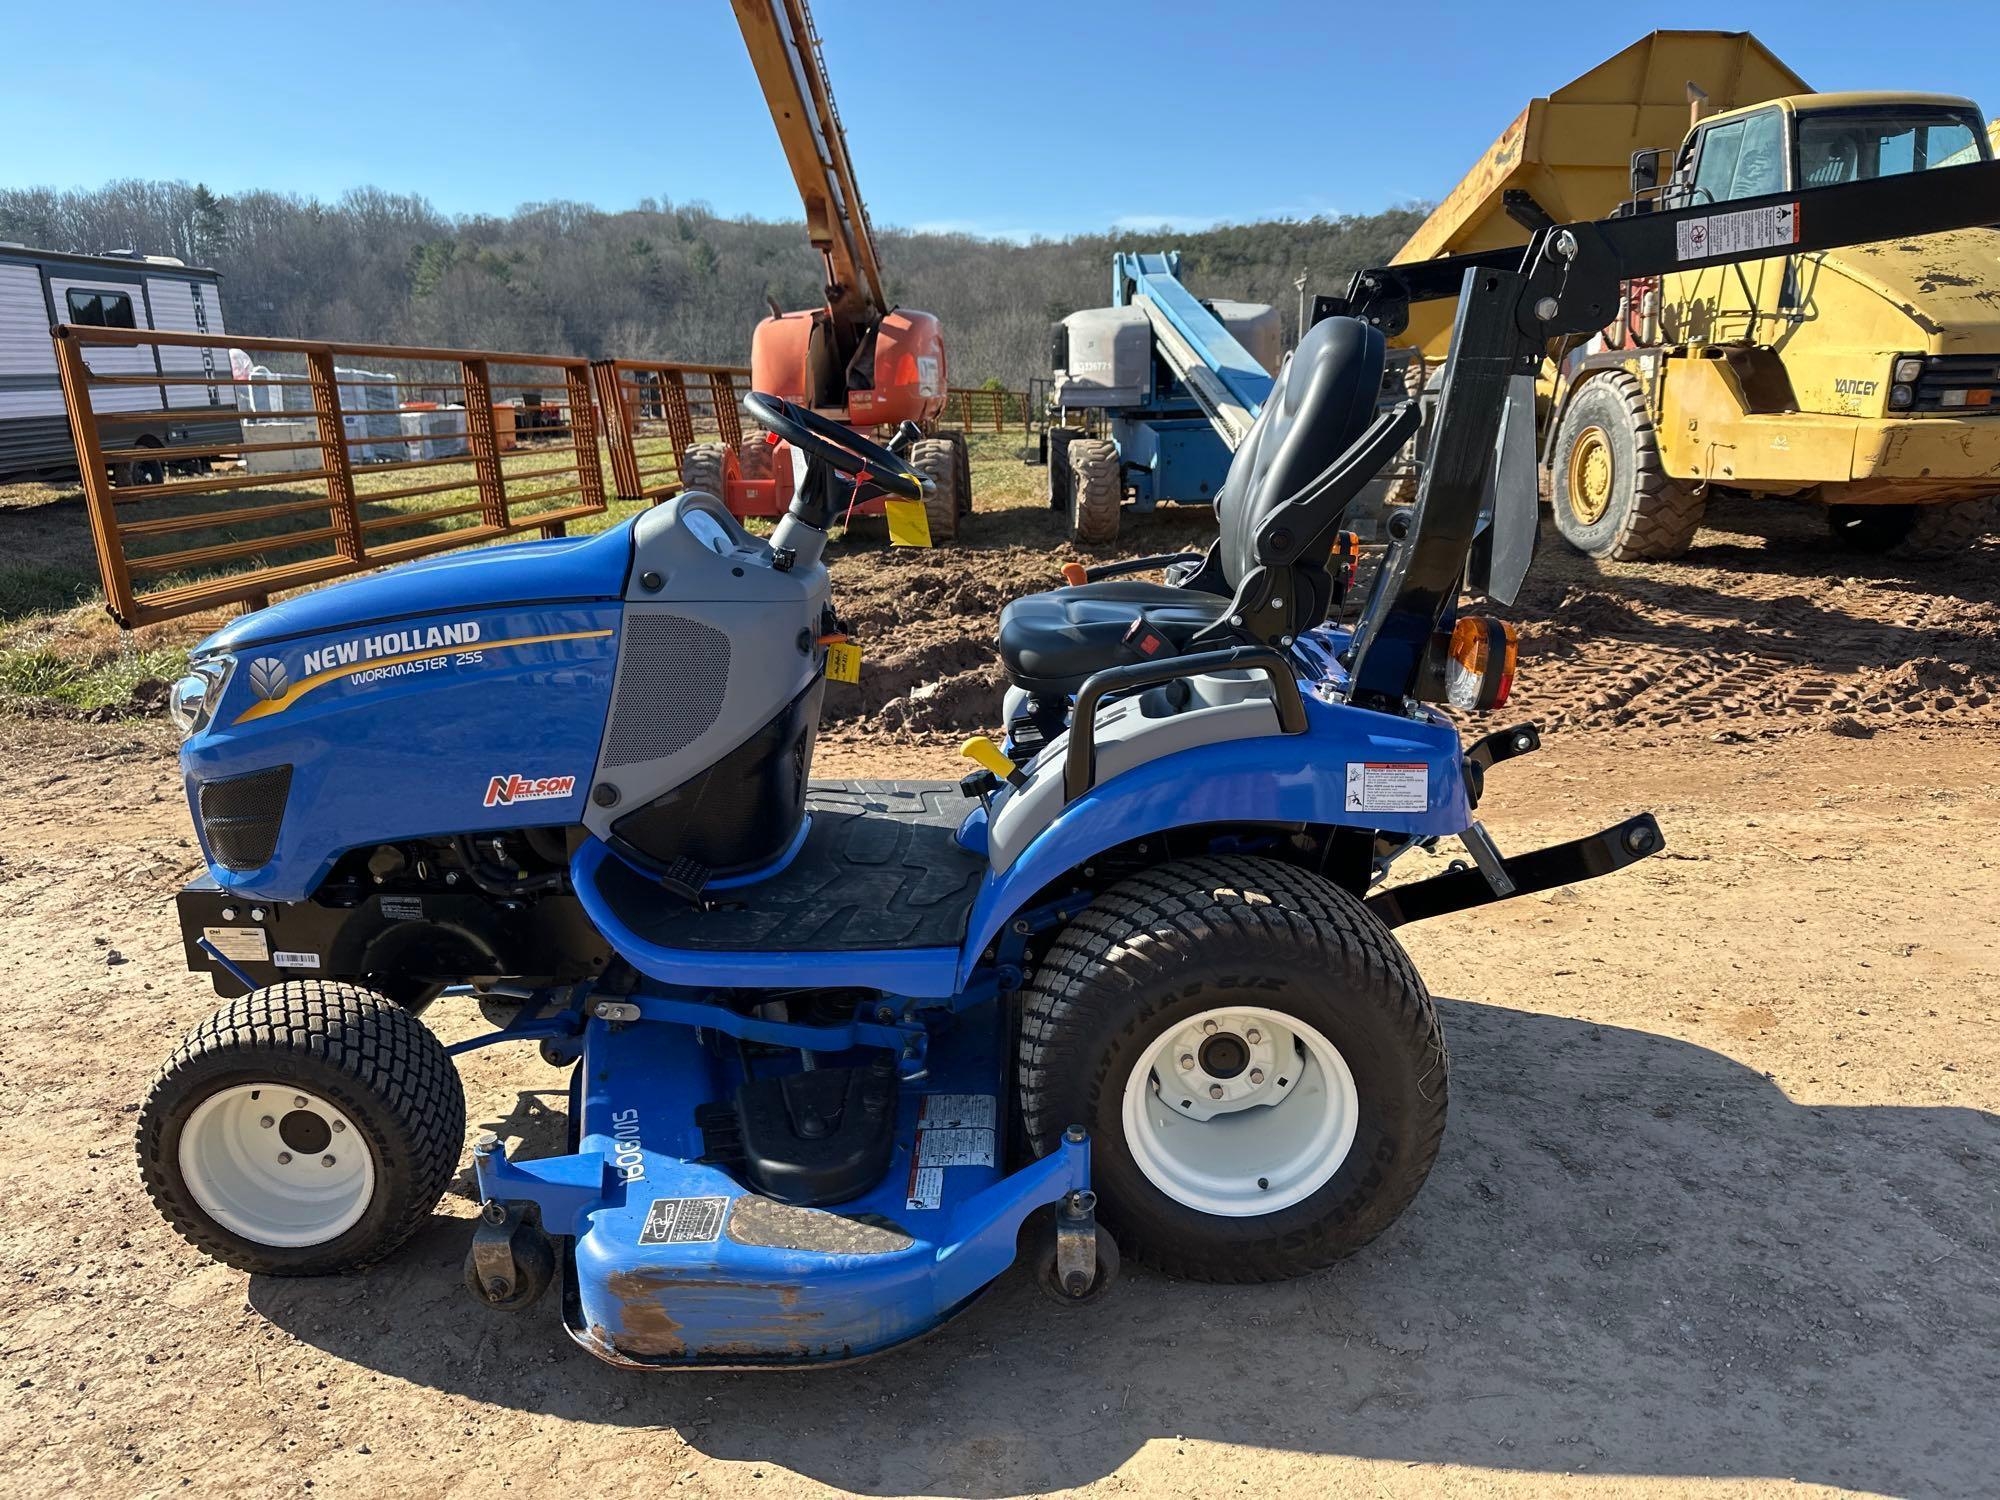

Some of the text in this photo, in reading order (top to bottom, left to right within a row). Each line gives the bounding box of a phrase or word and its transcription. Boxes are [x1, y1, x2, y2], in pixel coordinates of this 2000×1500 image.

[1835, 378, 1879, 396] YANCEY
[304, 622, 481, 676] NEW HOLLAND
[351, 651, 483, 686] WORKMASTER 25S
[485, 776, 574, 804] NELSON
